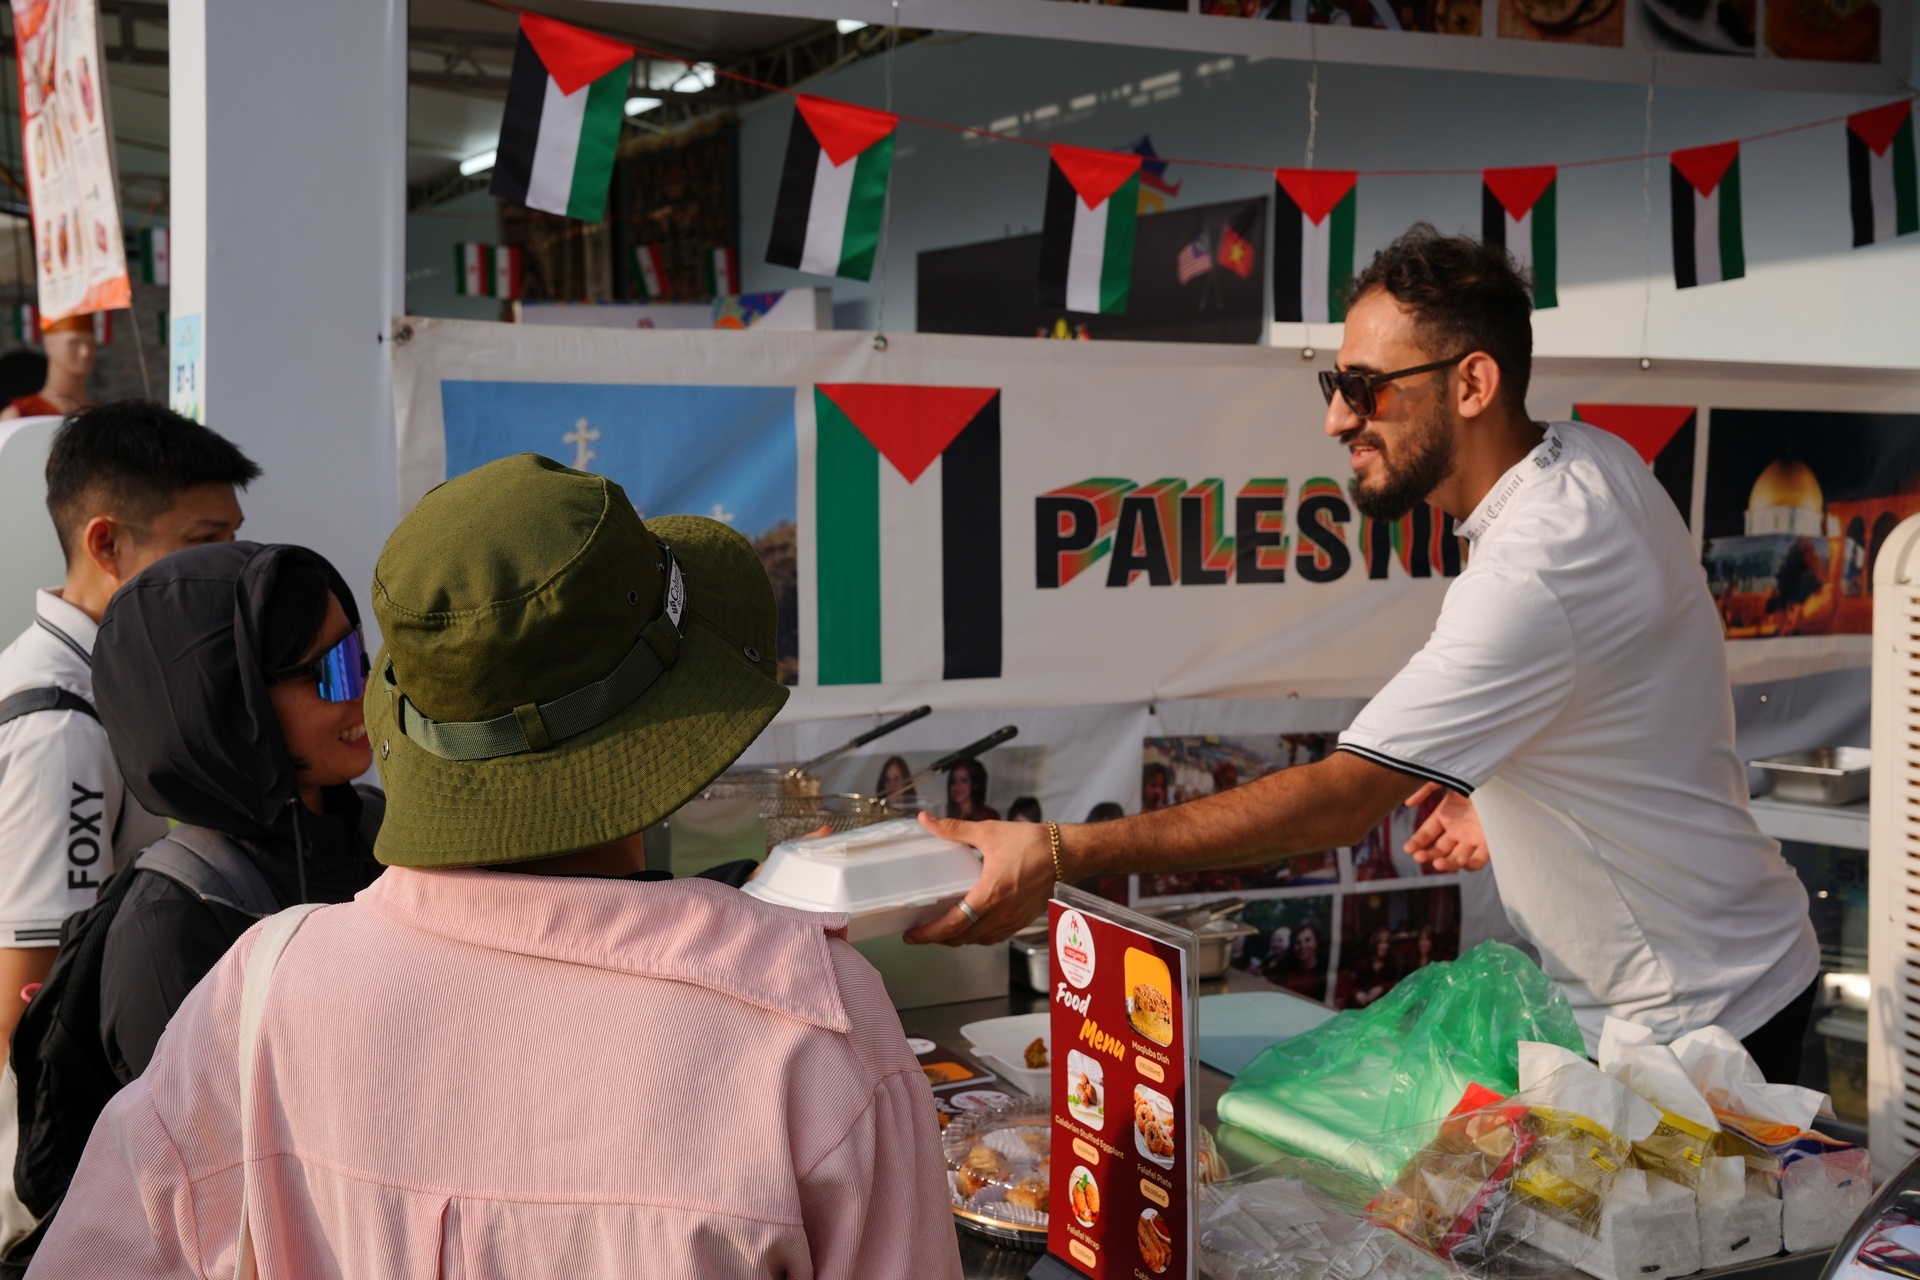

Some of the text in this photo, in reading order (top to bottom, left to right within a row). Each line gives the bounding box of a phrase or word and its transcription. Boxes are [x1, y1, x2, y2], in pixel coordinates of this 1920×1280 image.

[1035, 478, 1462, 589] PALESTI
[67, 781, 104, 890] FOXY
[1056, 982, 1092, 1018] Food
[1079, 1018, 1125, 1062] Menu
[1157, 1052, 1170, 1065] Dish
[1080, 1128, 1100, 1146] Stuffed
[1099, 1139, 1125, 1159] Eggplant
[1137, 1163, 1173, 1189] Falafel Plate
[1067, 1223, 1100, 1251] Falafel Wrap
